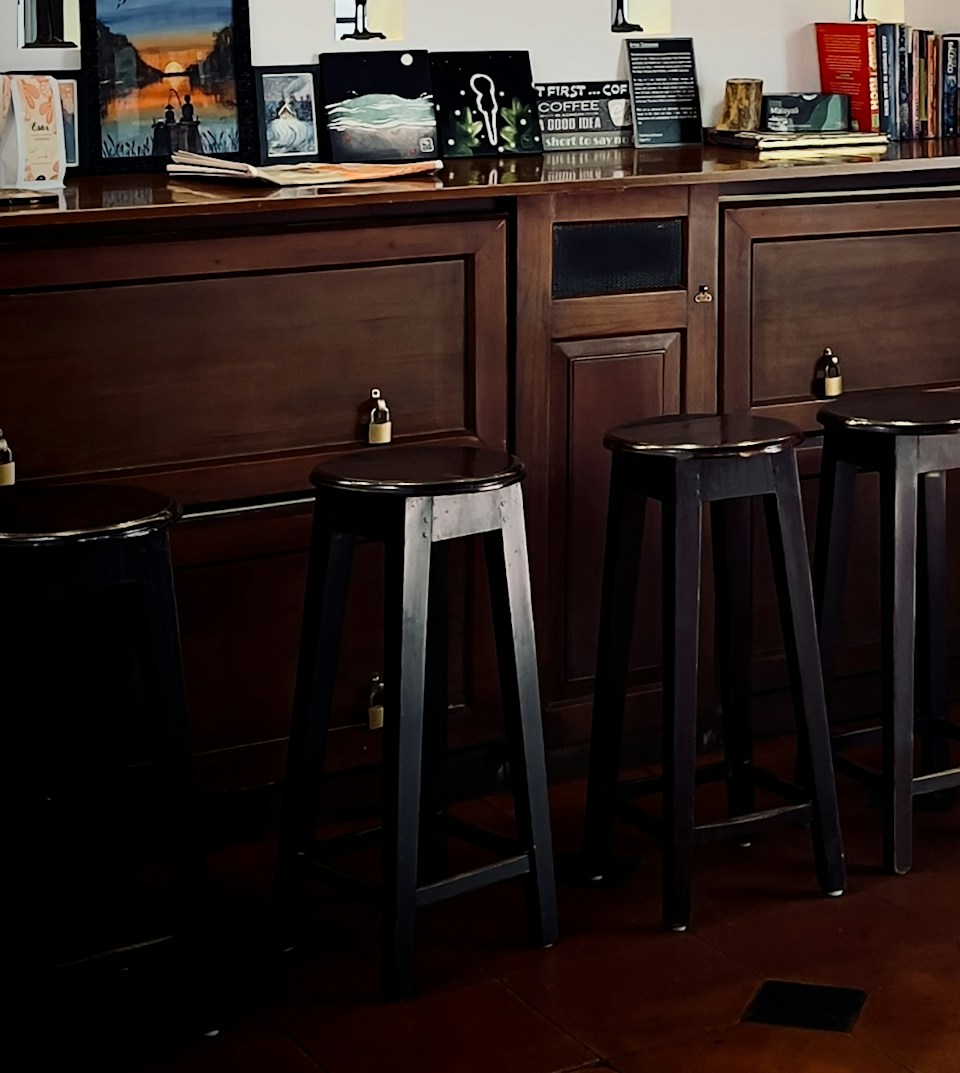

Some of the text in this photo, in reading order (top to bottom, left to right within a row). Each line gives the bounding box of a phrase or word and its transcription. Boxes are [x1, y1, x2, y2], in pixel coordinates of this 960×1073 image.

[547, 85, 586, 98] FIRST
[602, 84, 628, 96] COF
[868, 77, 880, 111] RICH
[538, 100, 600, 112] COFFEE
[547, 117, 576, 131] GOOD
[578, 116, 602, 129] IDEA
[545, 136, 577, 147] short
[578, 136, 591, 146] to
[593, 136, 613, 146] say
